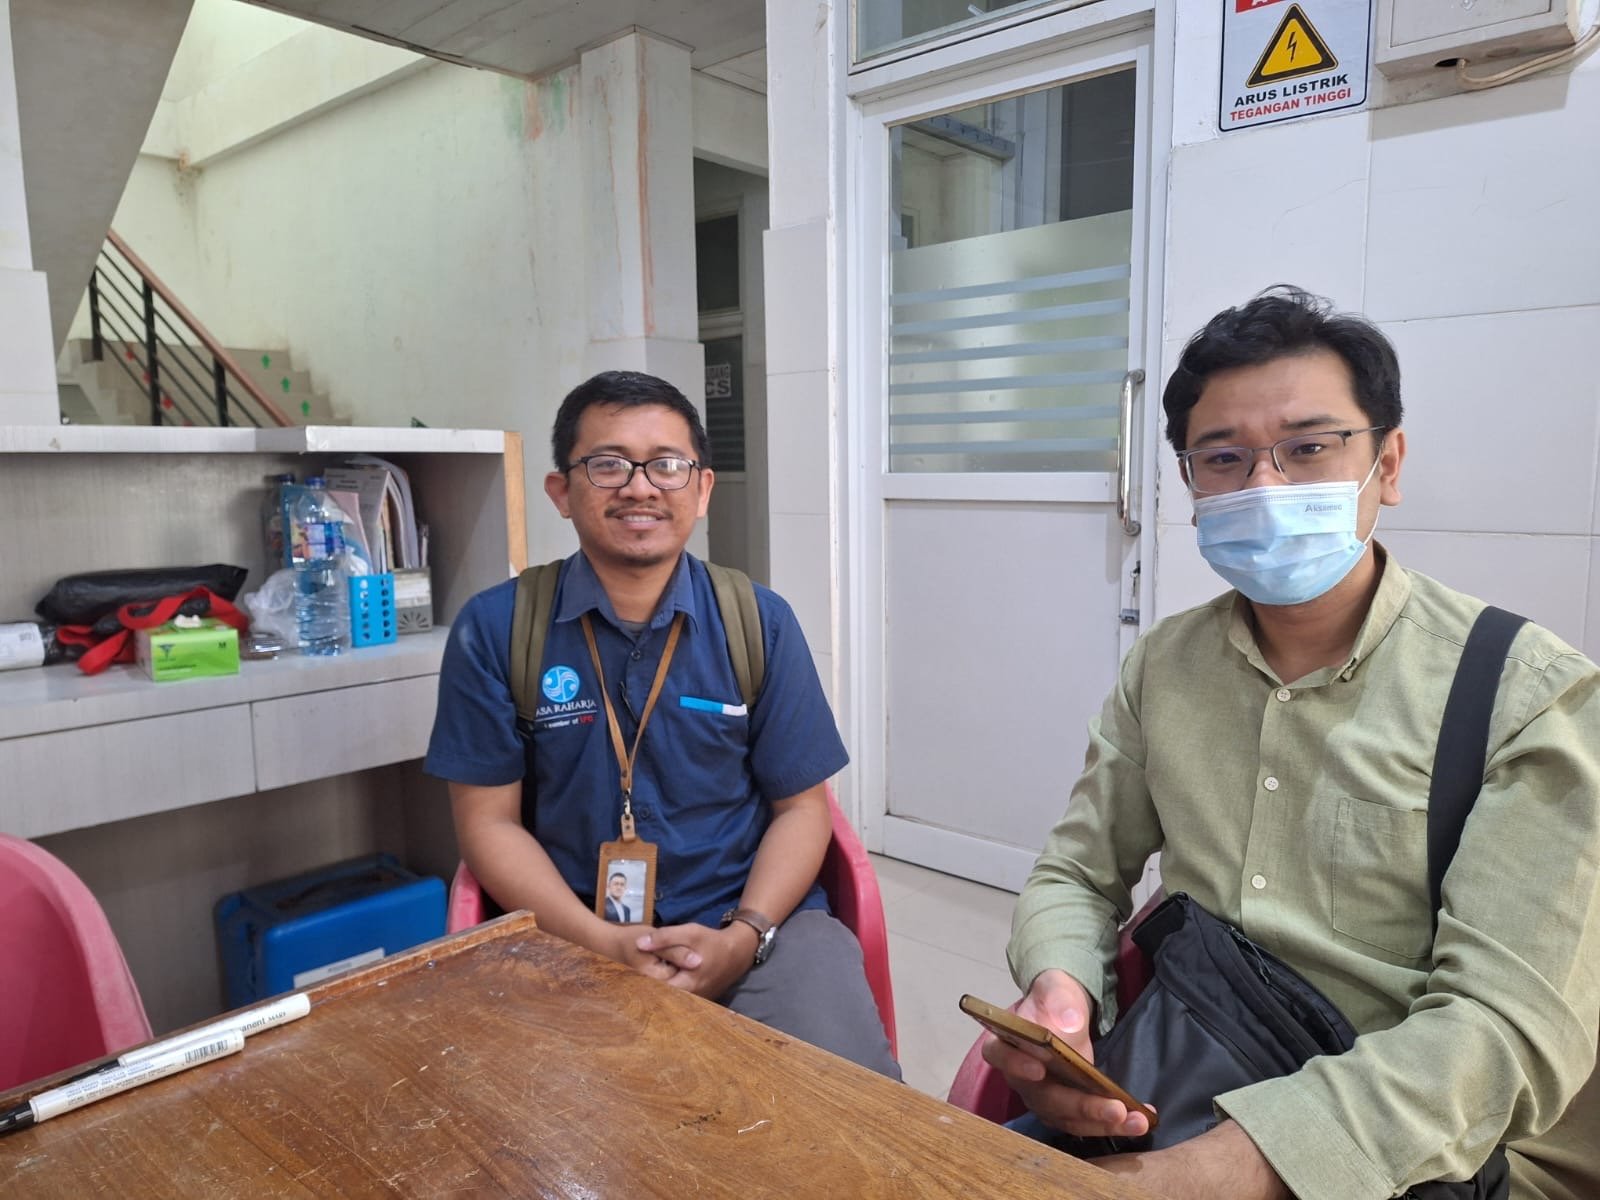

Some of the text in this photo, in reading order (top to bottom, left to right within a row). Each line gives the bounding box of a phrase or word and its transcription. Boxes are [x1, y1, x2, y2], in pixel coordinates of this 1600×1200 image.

[1230, 87, 1352, 121] TEGANGAN TINGGI
[1234, 74, 1349, 108] ARUS LISTRIK
[535, 699, 597, 717] ASA RAHARJA
